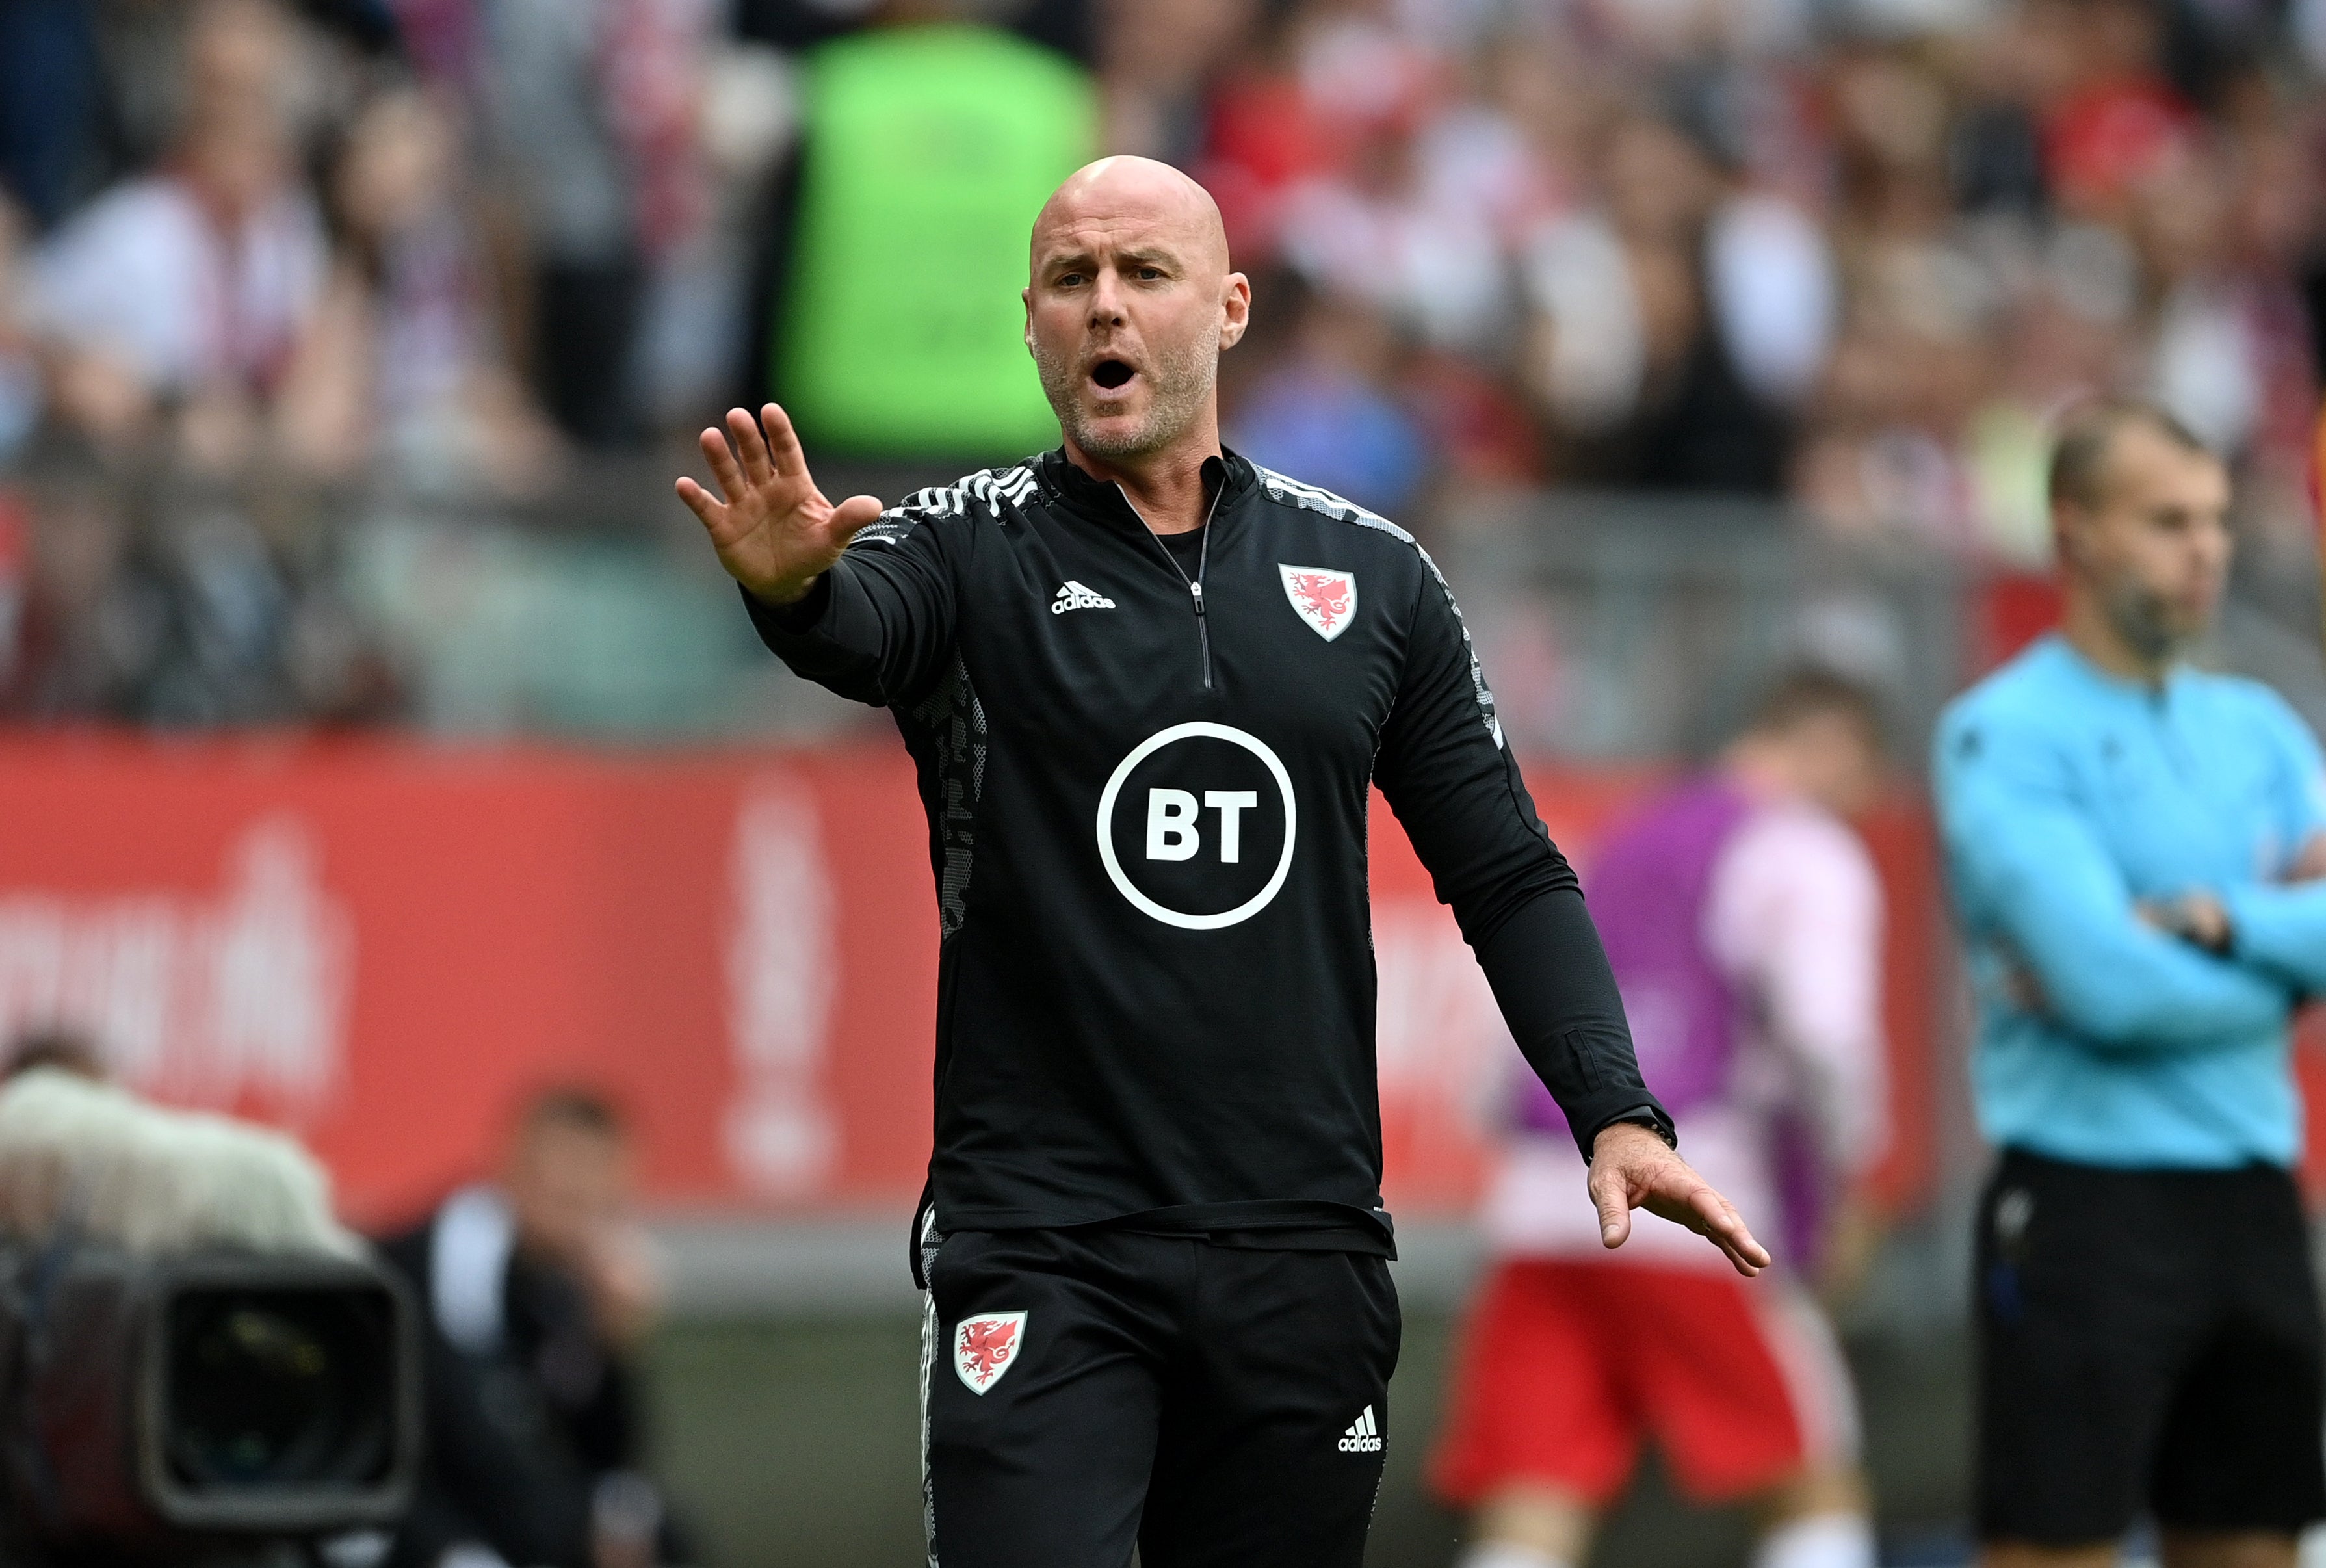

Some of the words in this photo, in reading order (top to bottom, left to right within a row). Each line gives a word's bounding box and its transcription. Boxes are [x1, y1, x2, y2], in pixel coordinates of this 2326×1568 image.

[1051, 592, 1116, 614] adidas
[1146, 787, 1257, 863] BT
[1338, 1434, 1381, 1452] adidas
